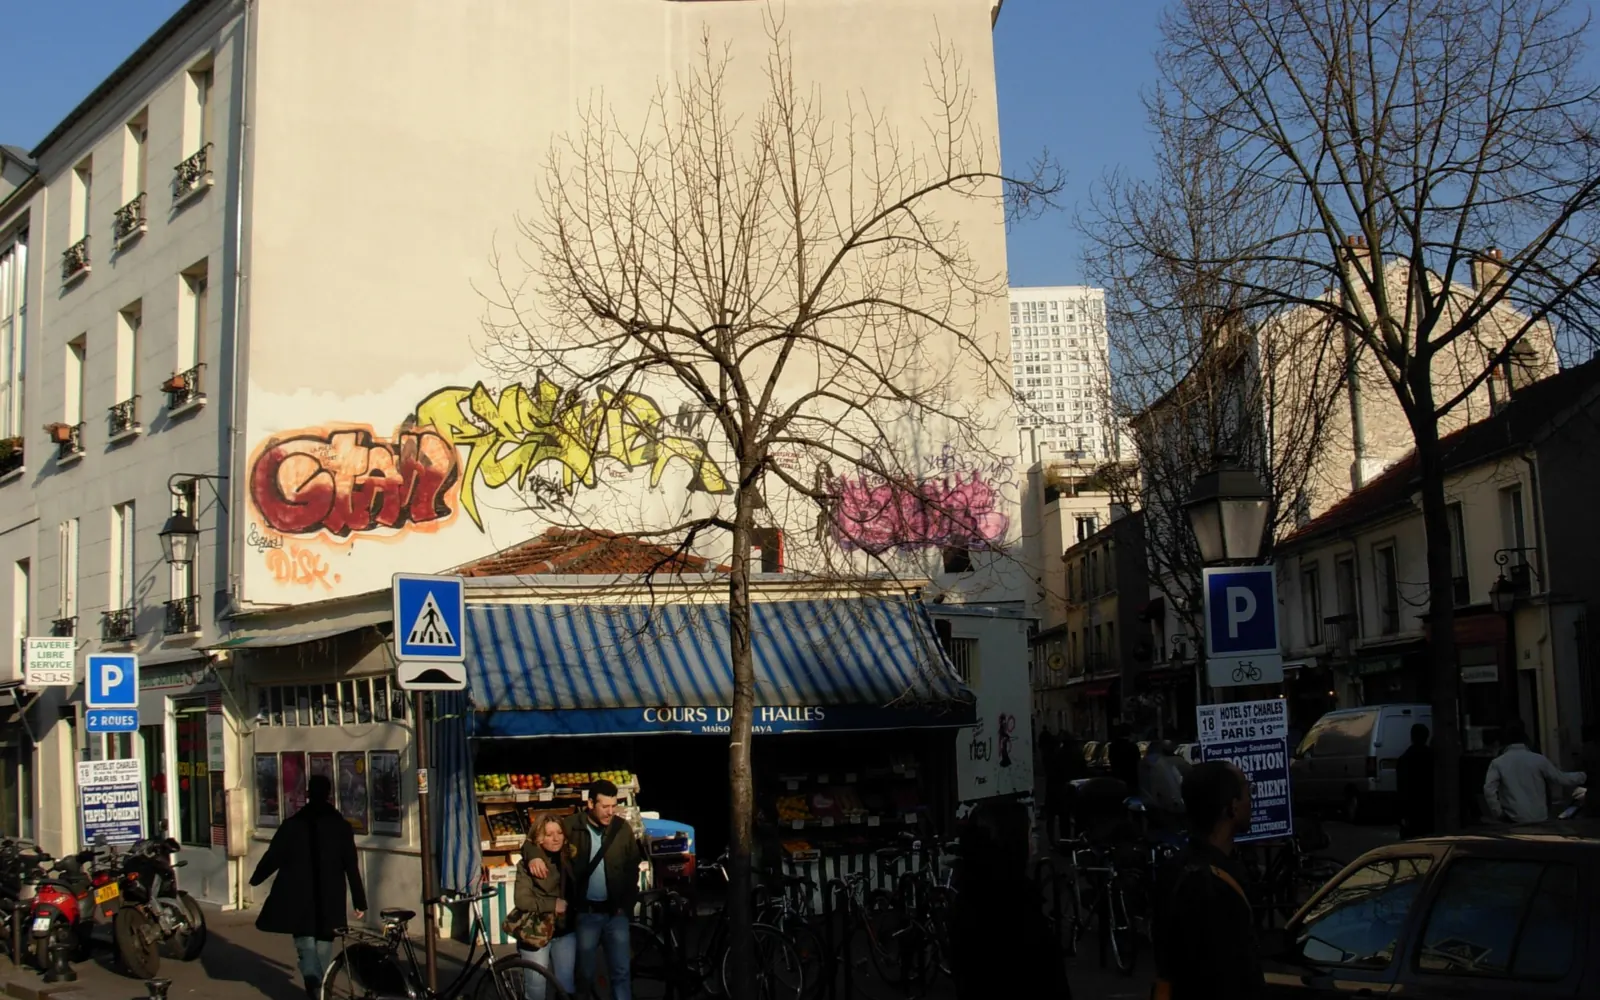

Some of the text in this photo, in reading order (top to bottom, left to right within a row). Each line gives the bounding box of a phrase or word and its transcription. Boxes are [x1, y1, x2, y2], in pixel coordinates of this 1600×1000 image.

[1226, 586, 1257, 638] P
[30, 641, 71, 649] LAVERIE
[37, 651, 65, 659] LIBRE
[30, 660, 73, 669] SERVICE
[101, 664, 124, 697] P
[643, 707, 708, 723] COURS
[761, 706, 826, 722] HALLES
[1220, 702, 1284, 720] HOTEL ST CHARLES
[90, 715, 135, 726] 2 ROUES
[1202, 716, 1215, 732] 18
[1240, 718, 1248, 726] de
[1221, 726, 1256, 740] PARIS
[1207, 747, 1223, 756] Pour
[1233, 744, 1248, 753] Jour
[84, 792, 138, 804] EXPOSITION
